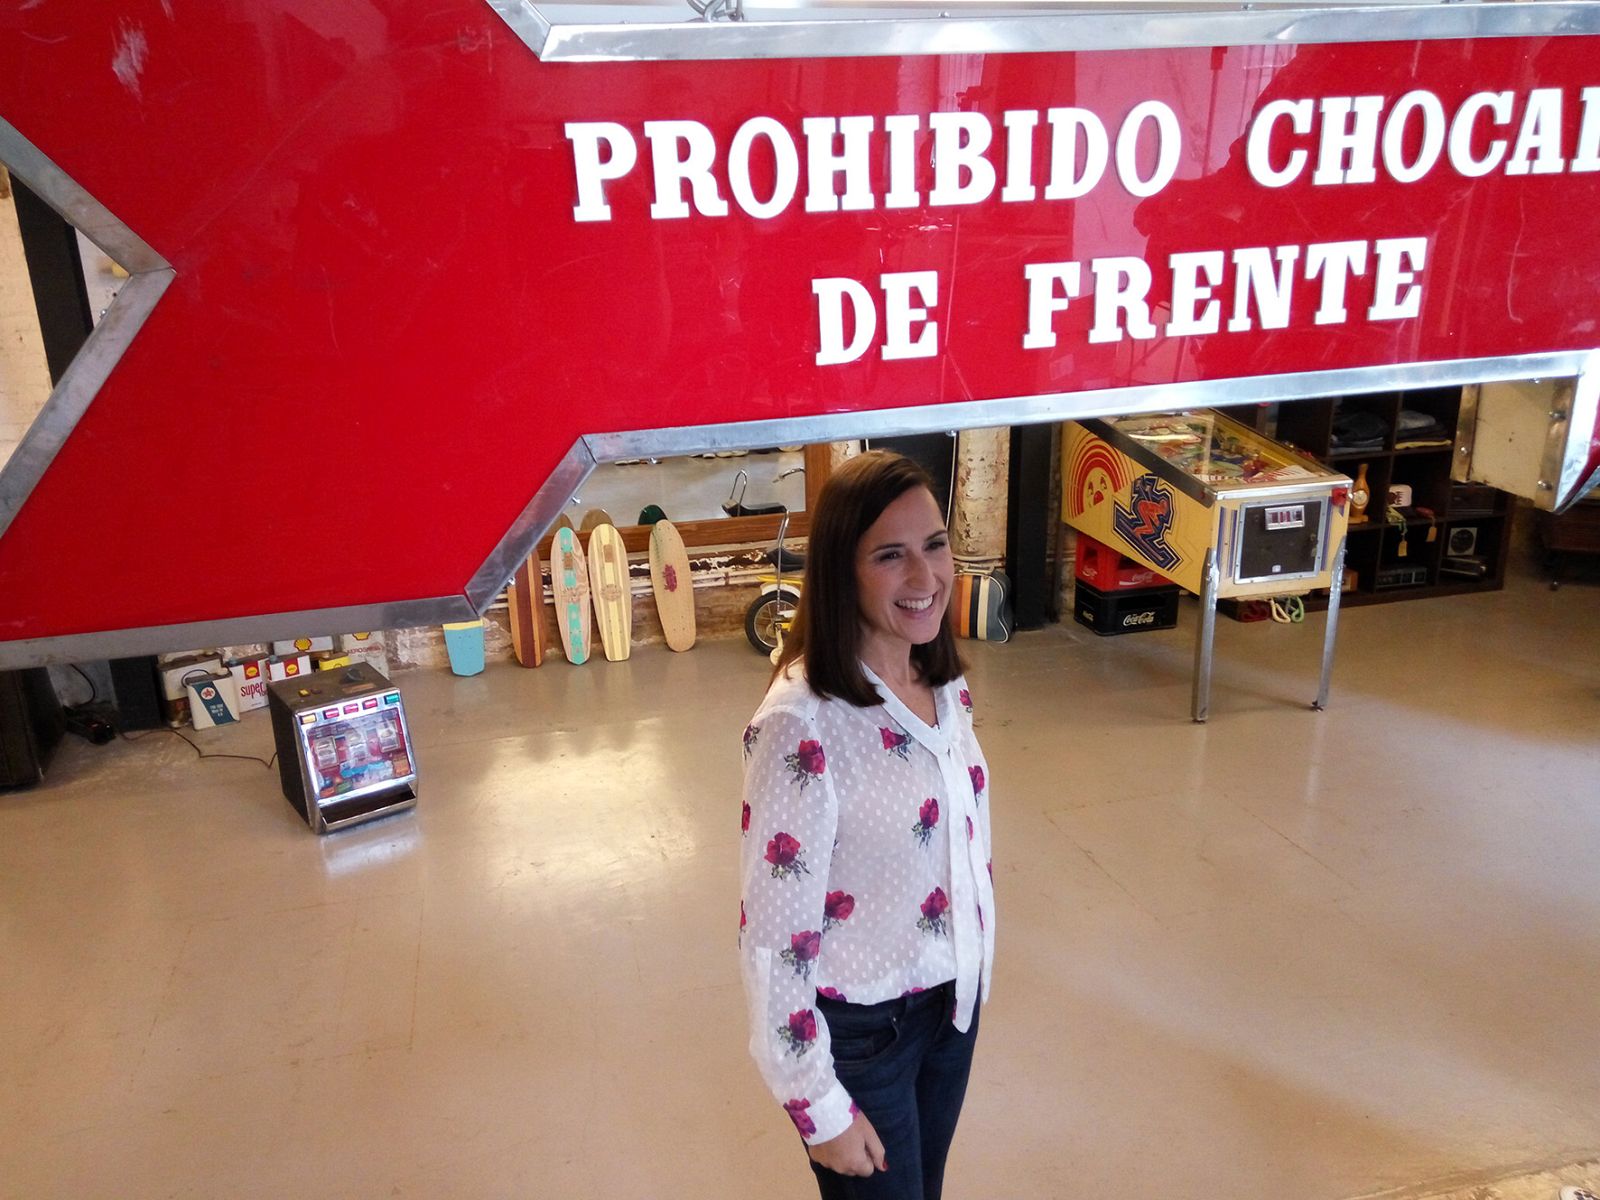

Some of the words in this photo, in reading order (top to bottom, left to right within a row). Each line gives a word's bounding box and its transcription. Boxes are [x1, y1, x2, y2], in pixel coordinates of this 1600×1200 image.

[564, 99, 1183, 222] PROHIBIDO
[811, 270, 938, 366] DE
[1023, 236, 1428, 350] FRENTE
